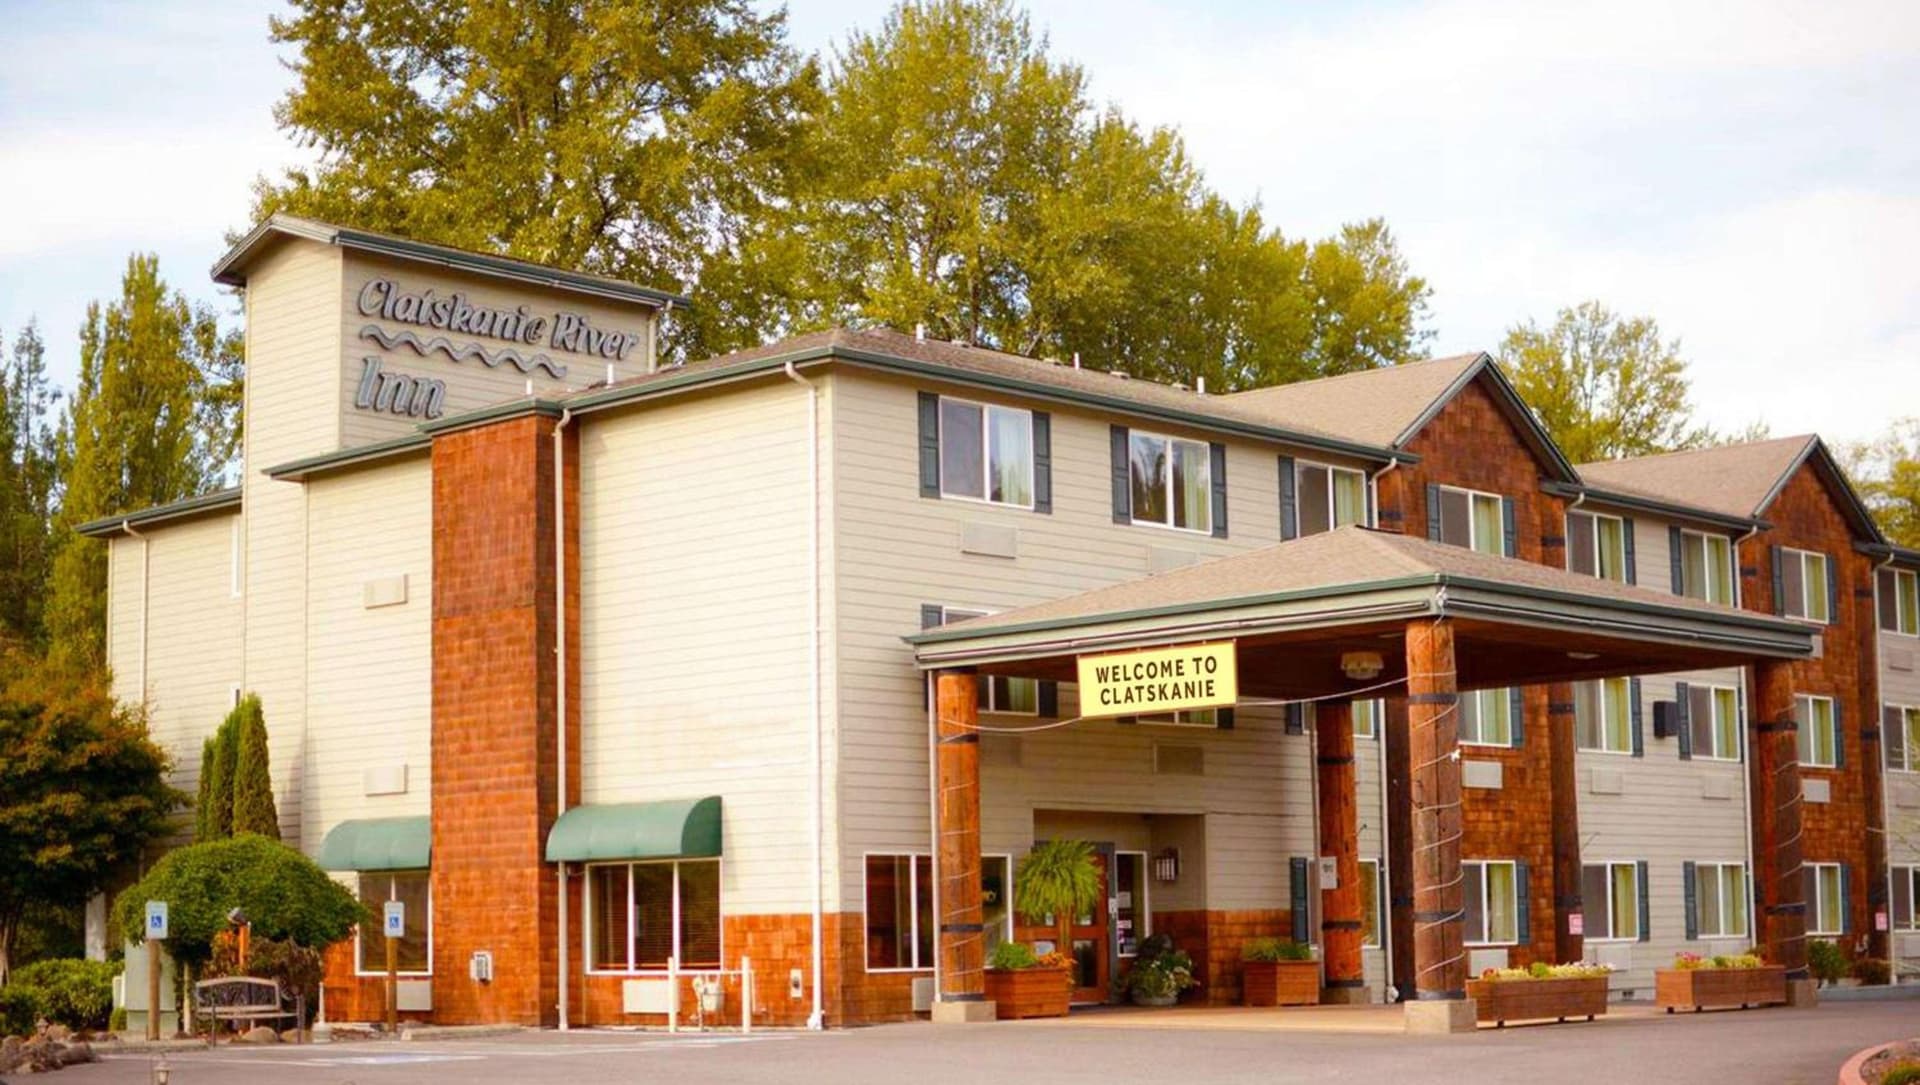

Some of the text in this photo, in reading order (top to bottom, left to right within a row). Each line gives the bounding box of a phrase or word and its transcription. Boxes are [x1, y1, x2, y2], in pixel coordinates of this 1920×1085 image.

[358, 278, 639, 360] Clatskanie River
[355, 356, 445, 419] Inn
[1095, 656, 1217, 684] WELCOME TO
[1100, 679, 1216, 706] CLATSKANIE
